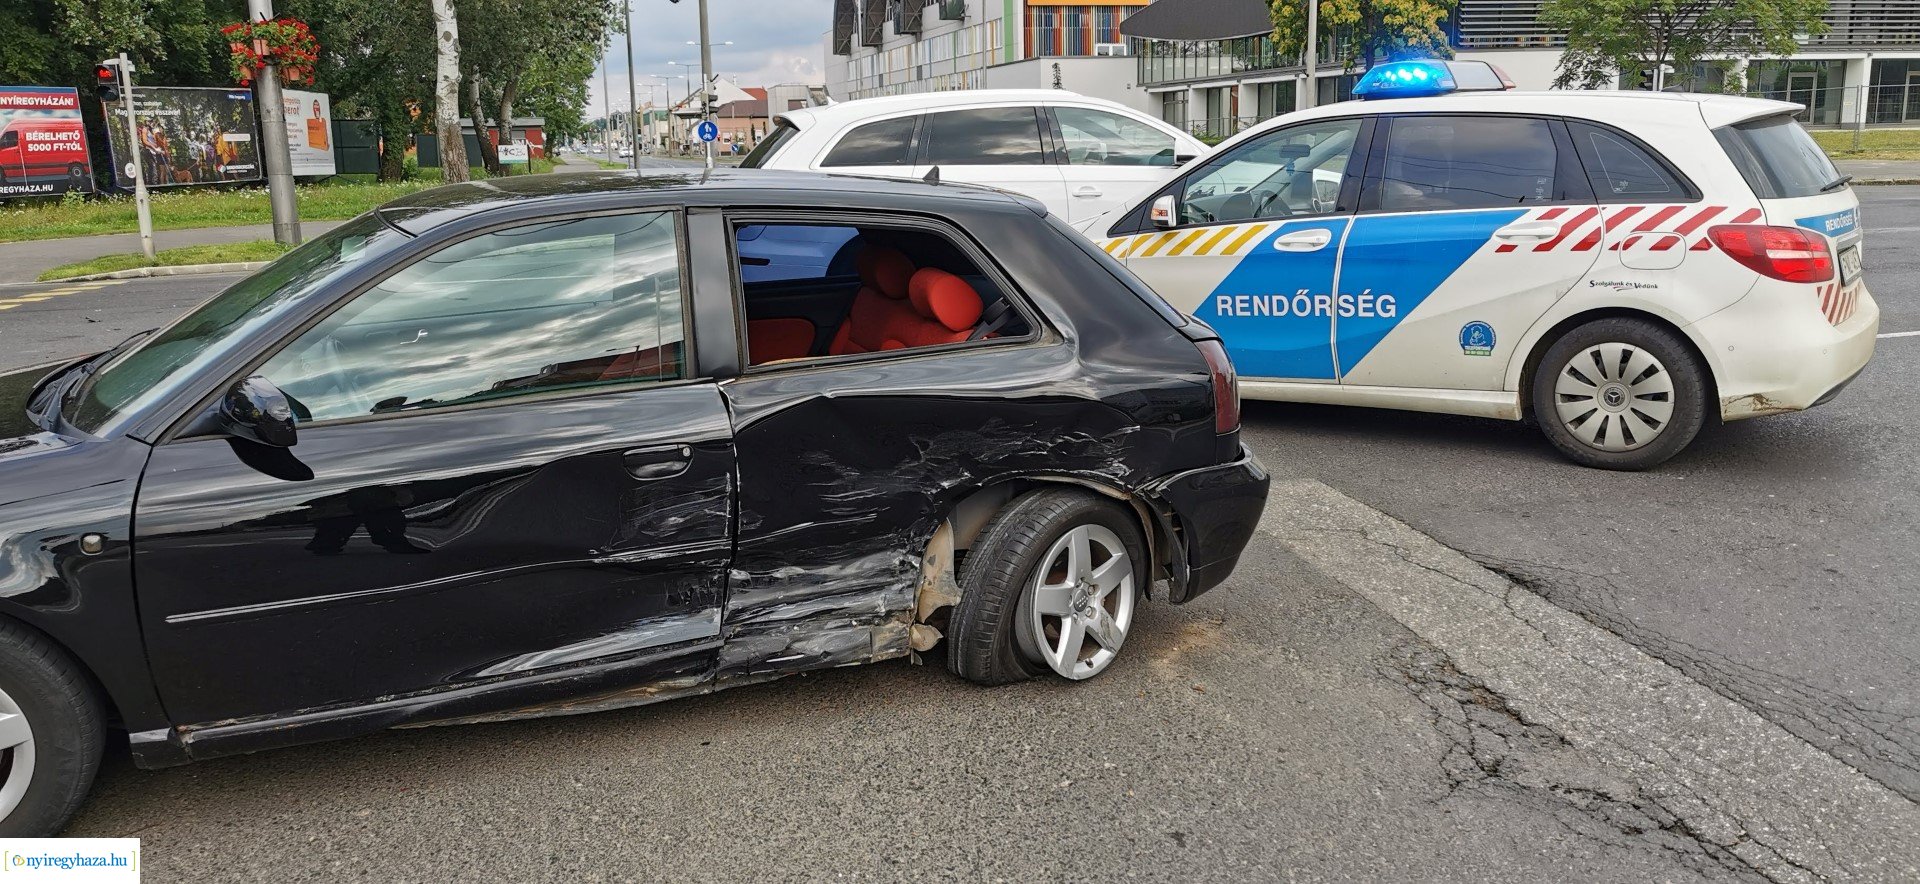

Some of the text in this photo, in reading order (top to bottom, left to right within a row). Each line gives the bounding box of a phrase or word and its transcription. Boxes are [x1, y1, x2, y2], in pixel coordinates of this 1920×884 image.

[26, 130, 81, 141] BÉRELHETŐ
[28, 142, 83, 152] 5000 FT-TÓL
[1216, 288, 1397, 318] RENDŐRSÉG
